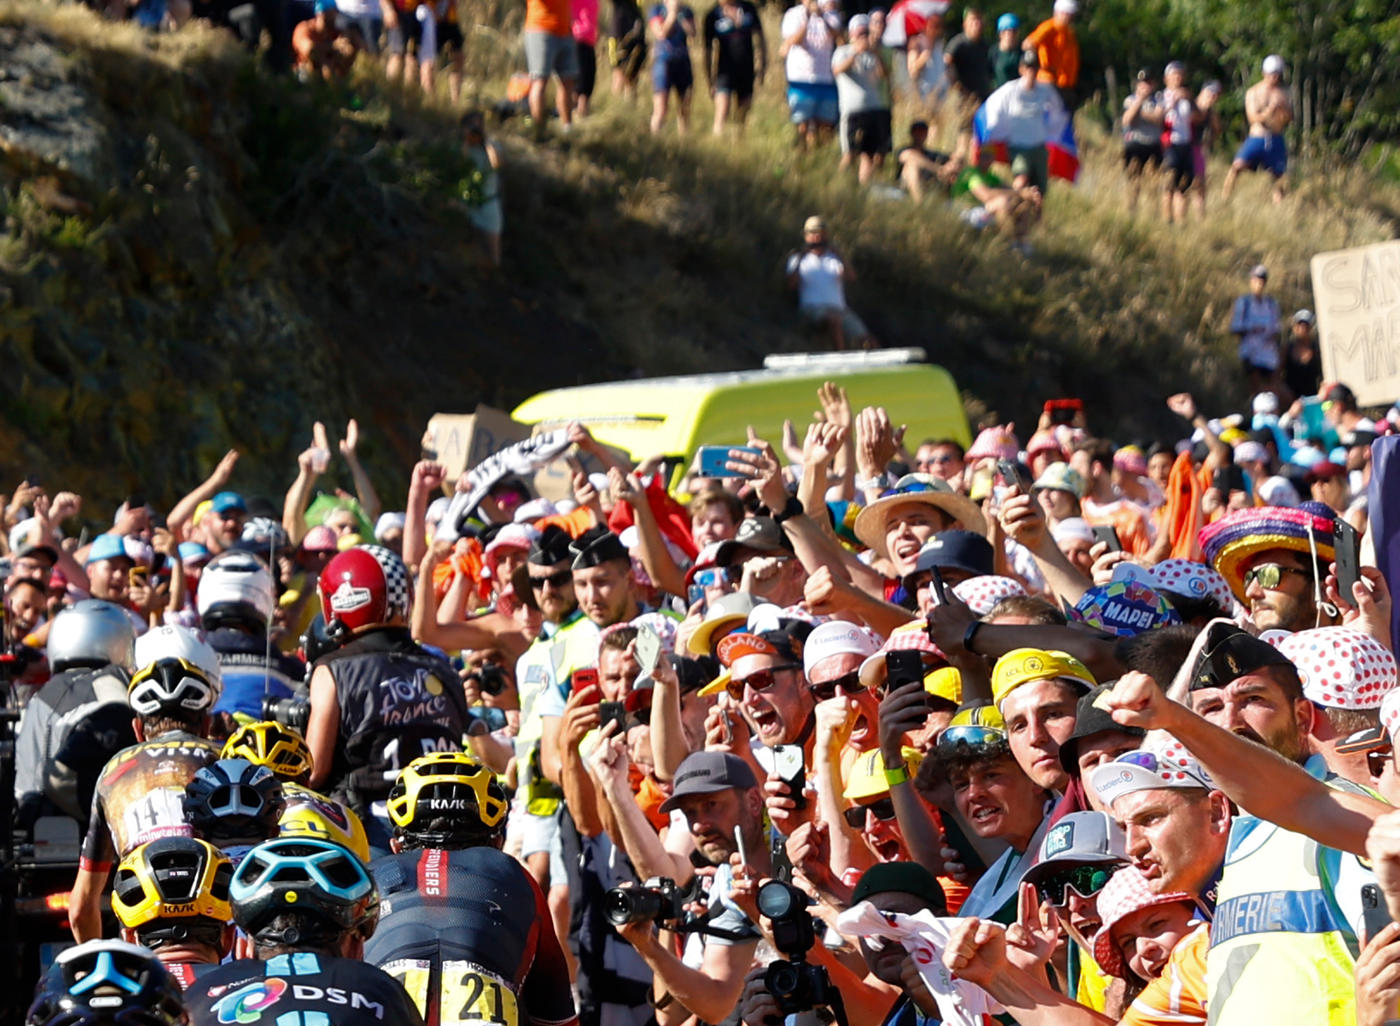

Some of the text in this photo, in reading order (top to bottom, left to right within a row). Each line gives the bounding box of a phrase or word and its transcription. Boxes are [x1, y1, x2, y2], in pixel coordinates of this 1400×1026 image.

[1105, 601, 1154, 629] MAPEI
[132, 796, 158, 833] 14
[430, 798, 466, 811] KASK
[164, 904, 194, 914] KASK
[292, 985, 384, 1020] DSM
[459, 972, 508, 1026] 21
